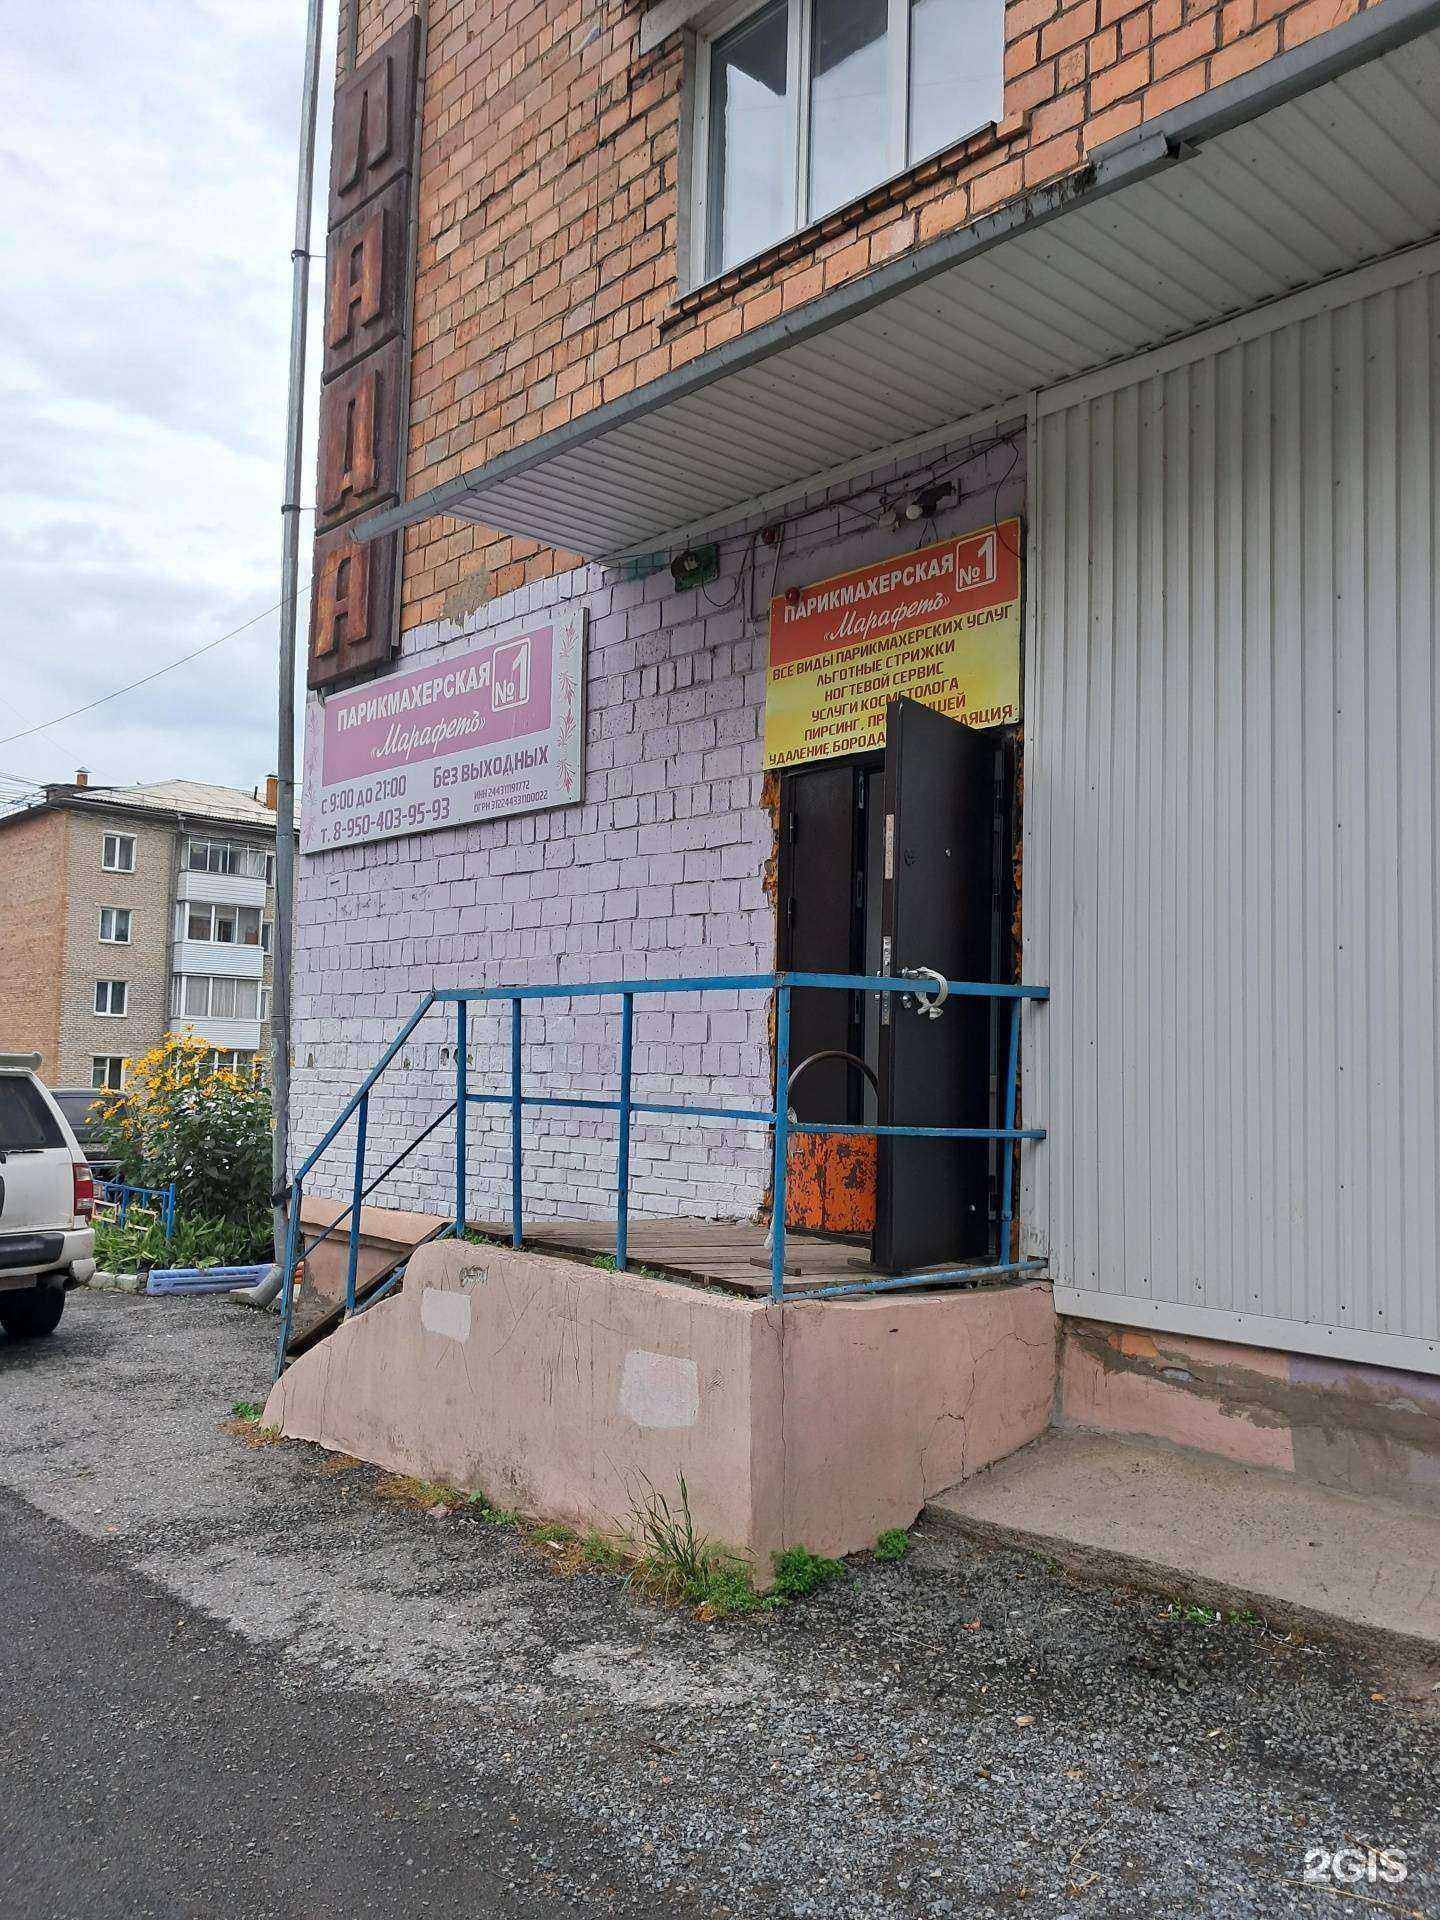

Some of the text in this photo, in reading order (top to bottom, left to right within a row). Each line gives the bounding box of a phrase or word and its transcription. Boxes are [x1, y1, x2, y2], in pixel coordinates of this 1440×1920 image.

[784, 553, 954, 623] ПАРИКМАХЕРСКАЯ
[773, 604, 1013, 680] ВСЕ ВИДЫ ПАРИКМАХЕРСКИХ УСЛУГ
[817, 640, 955, 686] ЛЬГОТНЫЕ СТРИЖКИ
[825, 662, 944, 702] НОГТЕВОЙ СЕРВИС
[337, 660, 491, 732] ПАРИКМАХЕРСКАЯ
[812, 702, 858, 722] УСЛУГИ
[921, 691, 966, 712] ШЕЙ
[769, 743, 830, 765] УДАЛЕНИЕ
[833, 732, 885, 753] БОРОДА
[330, 788, 354, 813] 9:00
[375, 775, 407, 801] 21:00
[434, 766, 459, 788] Без
[333, 797, 450, 841] 8-950-403-95-93
[474, 802, 491, 813] ОГРН
